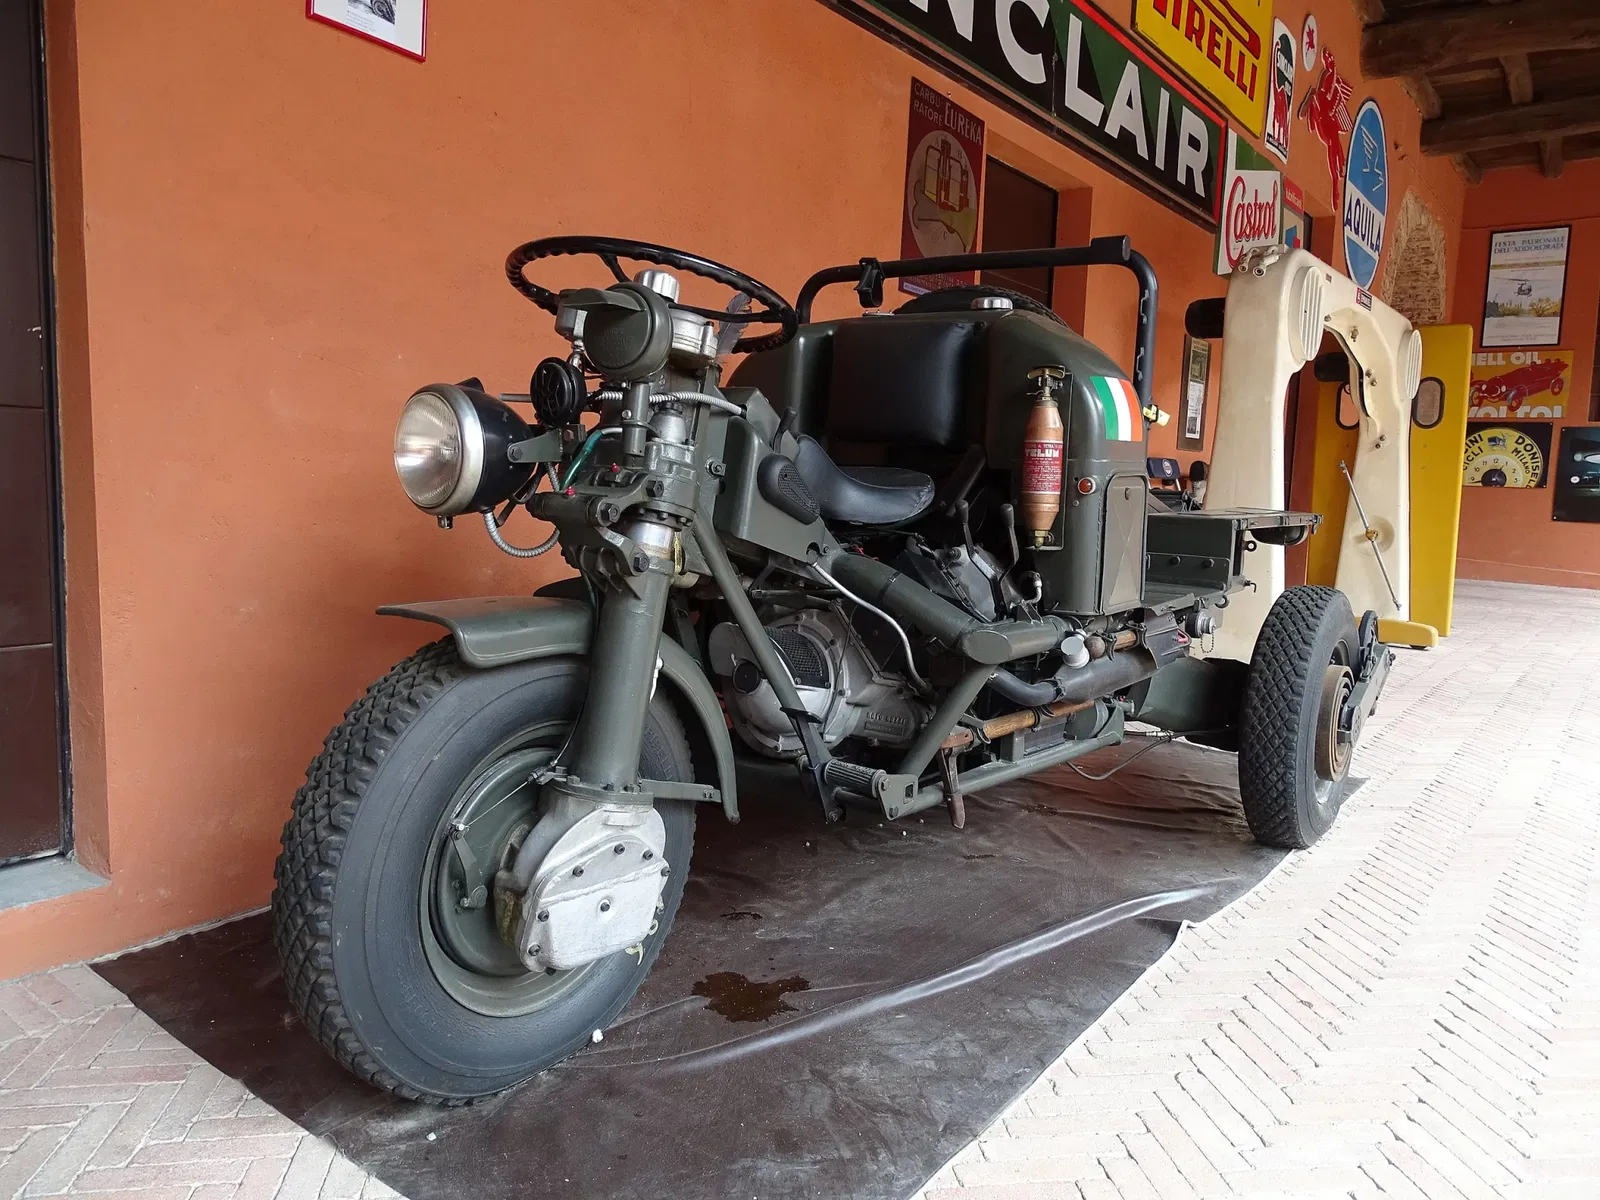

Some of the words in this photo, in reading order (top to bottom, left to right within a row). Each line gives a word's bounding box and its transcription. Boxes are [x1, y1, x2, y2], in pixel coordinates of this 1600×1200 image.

[913, 100, 943, 126] RATORE
[944, 100, 982, 146] EUREKA
[1226, 175, 1278, 269] Castrol
[1344, 192, 1381, 256] AQUILA
[1494, 240, 1516, 248] FESTA
[1521, 236, 1565, 246] PATRONALE
[1494, 243, 1564, 254] DELL'ADDOLORATA
[1510, 351, 1542, 365] OIL
[1025, 448, 1060, 458] TELUM
[1511, 447, 1530, 475] MILANO
